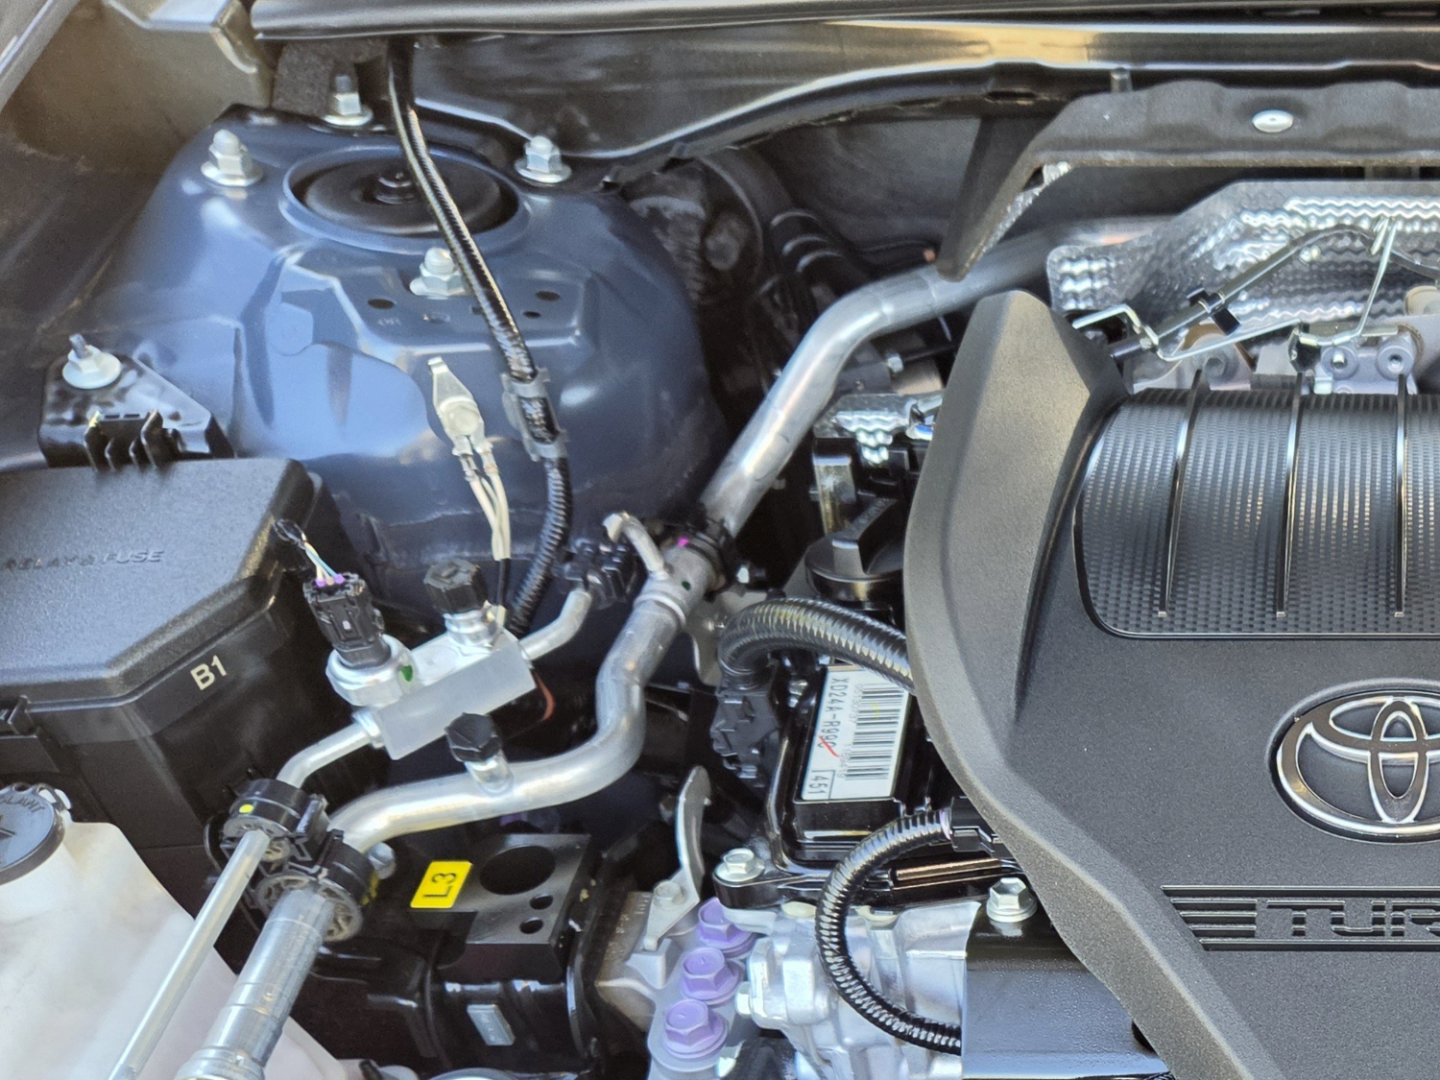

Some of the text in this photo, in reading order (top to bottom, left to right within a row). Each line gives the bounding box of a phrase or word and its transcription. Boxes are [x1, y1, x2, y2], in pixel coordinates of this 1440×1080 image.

[101, 550, 164, 565] FUSE
[190, 655, 227, 690] B1
[807, 774, 830, 795] 451
[422, 872, 457, 898] L3
